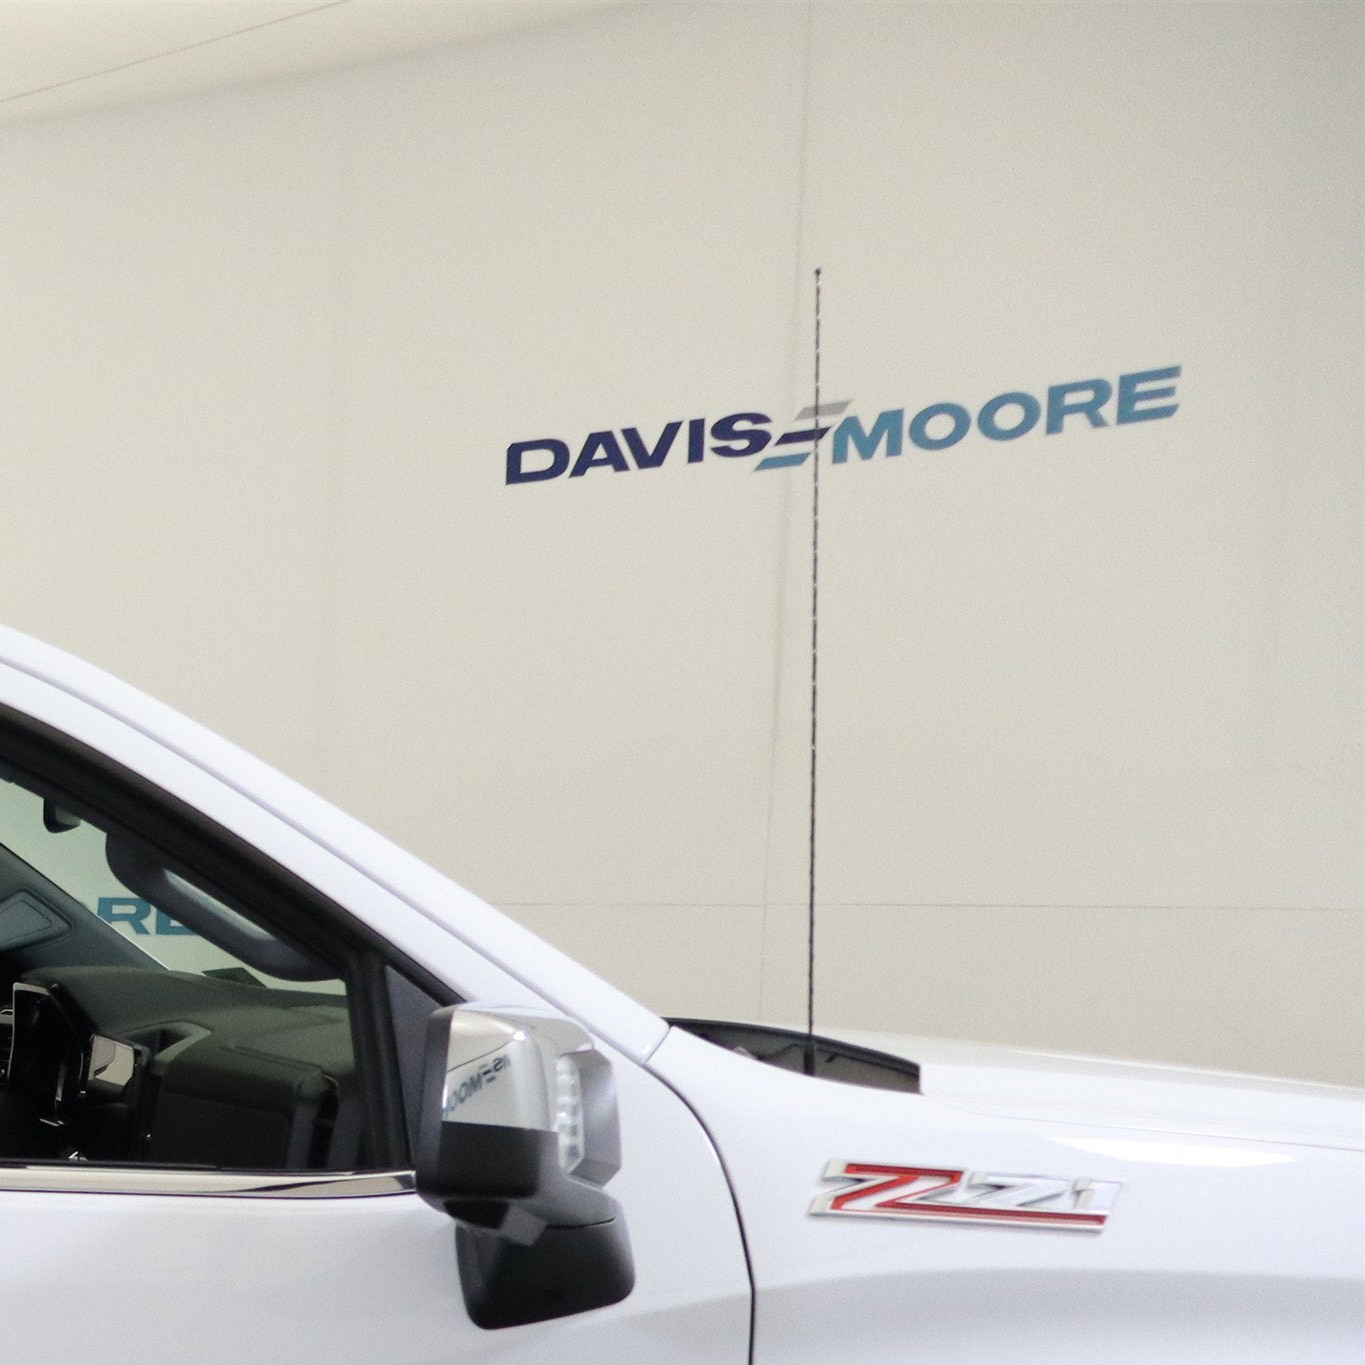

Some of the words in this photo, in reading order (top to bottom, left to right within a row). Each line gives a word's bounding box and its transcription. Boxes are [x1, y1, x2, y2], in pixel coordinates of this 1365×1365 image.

[505, 412, 773, 485] DAVIS
[831, 365, 1181, 465] MOORE
[809, 1158, 1124, 1233] Z71
